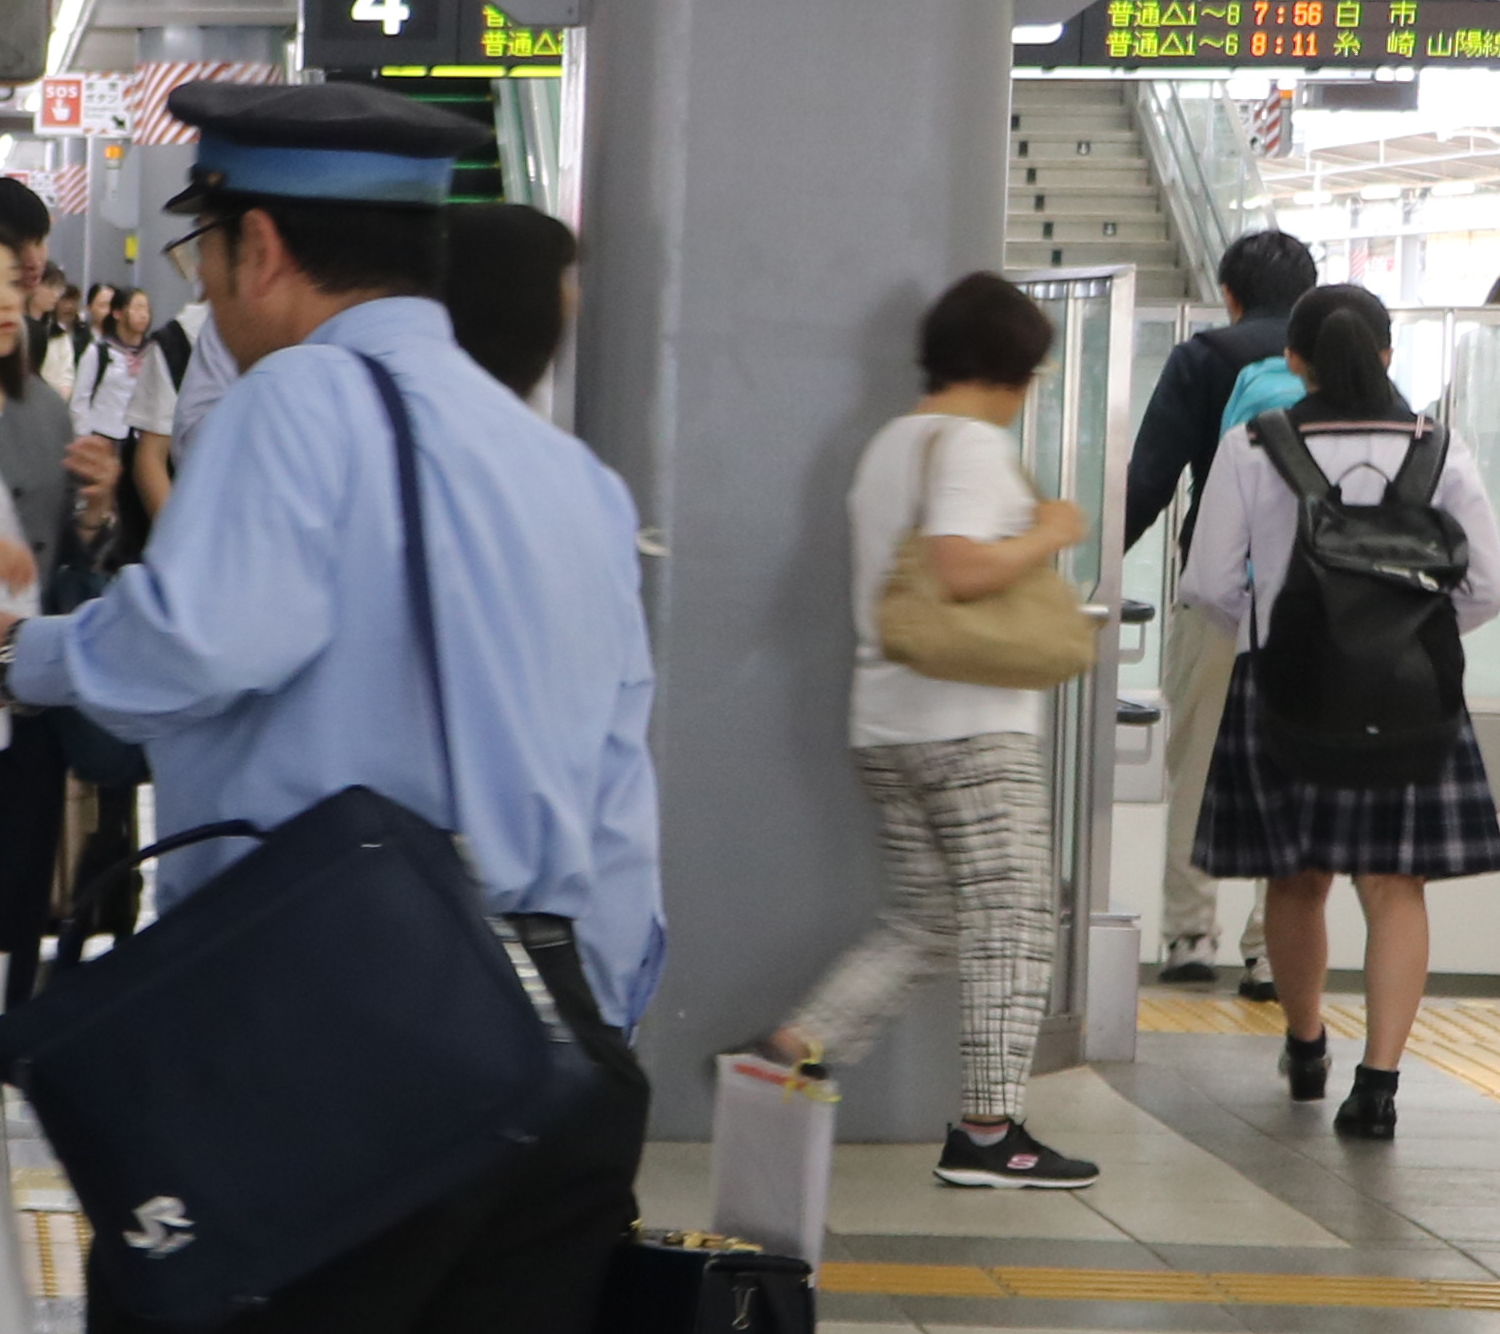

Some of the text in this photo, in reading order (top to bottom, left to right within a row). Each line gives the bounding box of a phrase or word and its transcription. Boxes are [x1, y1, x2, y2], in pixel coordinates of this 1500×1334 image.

[1253, 1, 1324, 27] 7:56
[1249, 32, 1319, 58] 8:11
[46, 85, 79, 99] SOS
